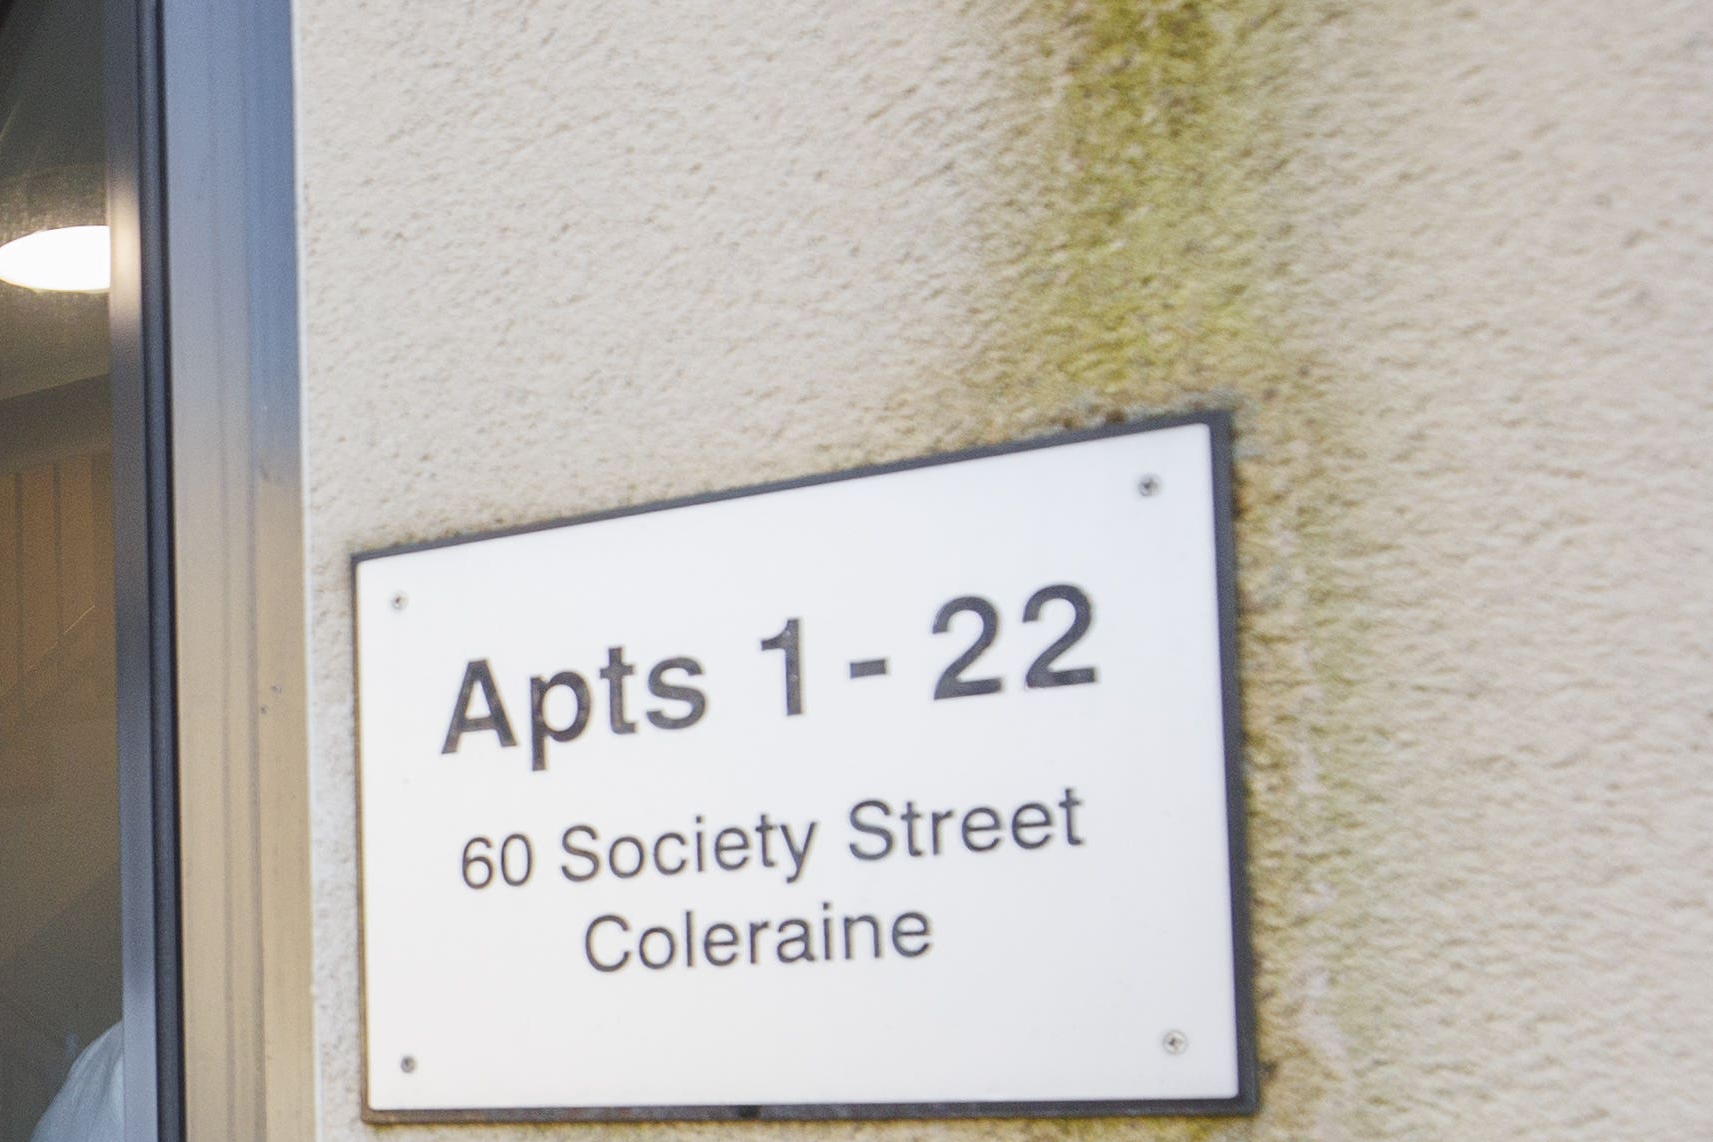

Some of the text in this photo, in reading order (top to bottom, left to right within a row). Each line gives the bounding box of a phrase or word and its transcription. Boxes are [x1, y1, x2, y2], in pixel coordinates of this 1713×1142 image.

[439, 645, 708, 773] Apts
[759, 616, 804, 718] 1
[930, 582, 1098, 702] 22
[460, 787, 1085, 891] 60 Society Street
[583, 902, 932, 974] Coleraine
